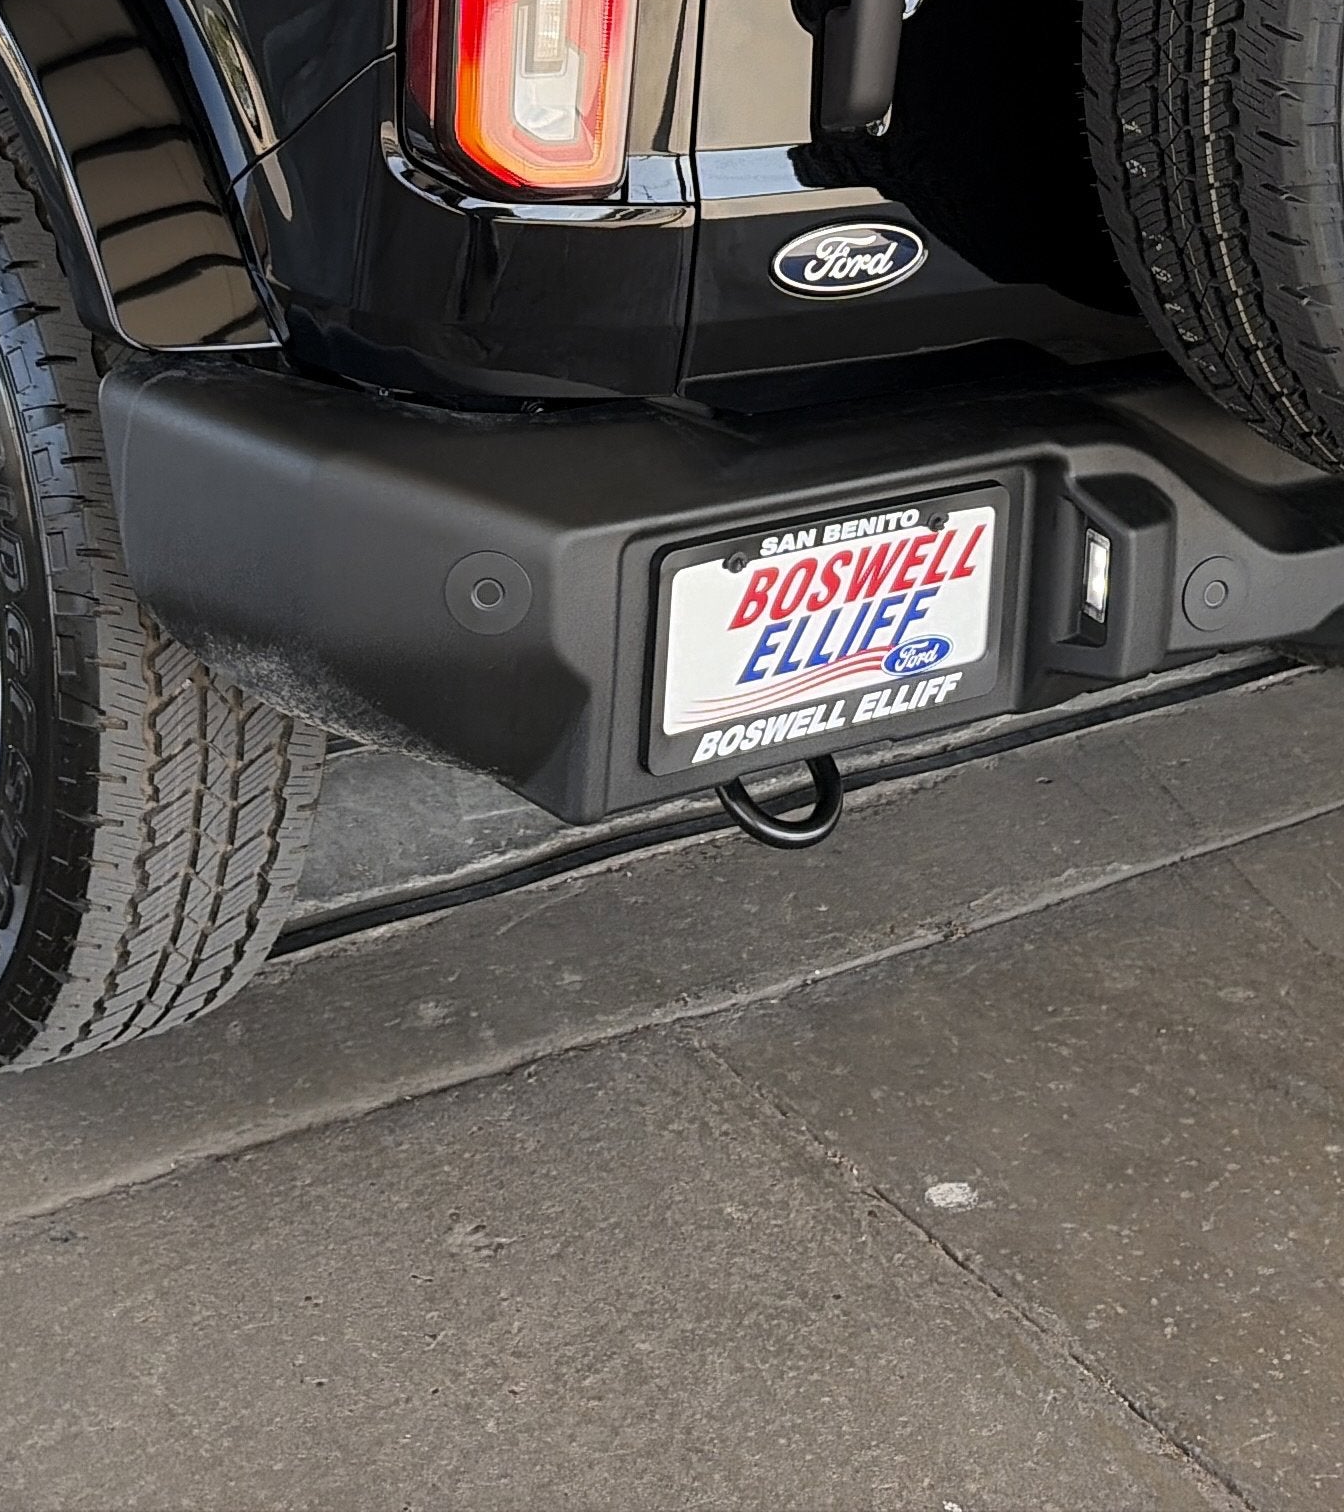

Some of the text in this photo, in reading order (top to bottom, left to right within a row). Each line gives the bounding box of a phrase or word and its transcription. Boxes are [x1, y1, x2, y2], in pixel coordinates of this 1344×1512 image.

[804, 235, 899, 282] Ford
[727, 523, 987, 631] BOSWELL
[759, 508, 921, 557] SAN BENITO
[735, 586, 941, 685] ELLIFF
[691, 672, 963, 764] BOSWELL ELLIFF
